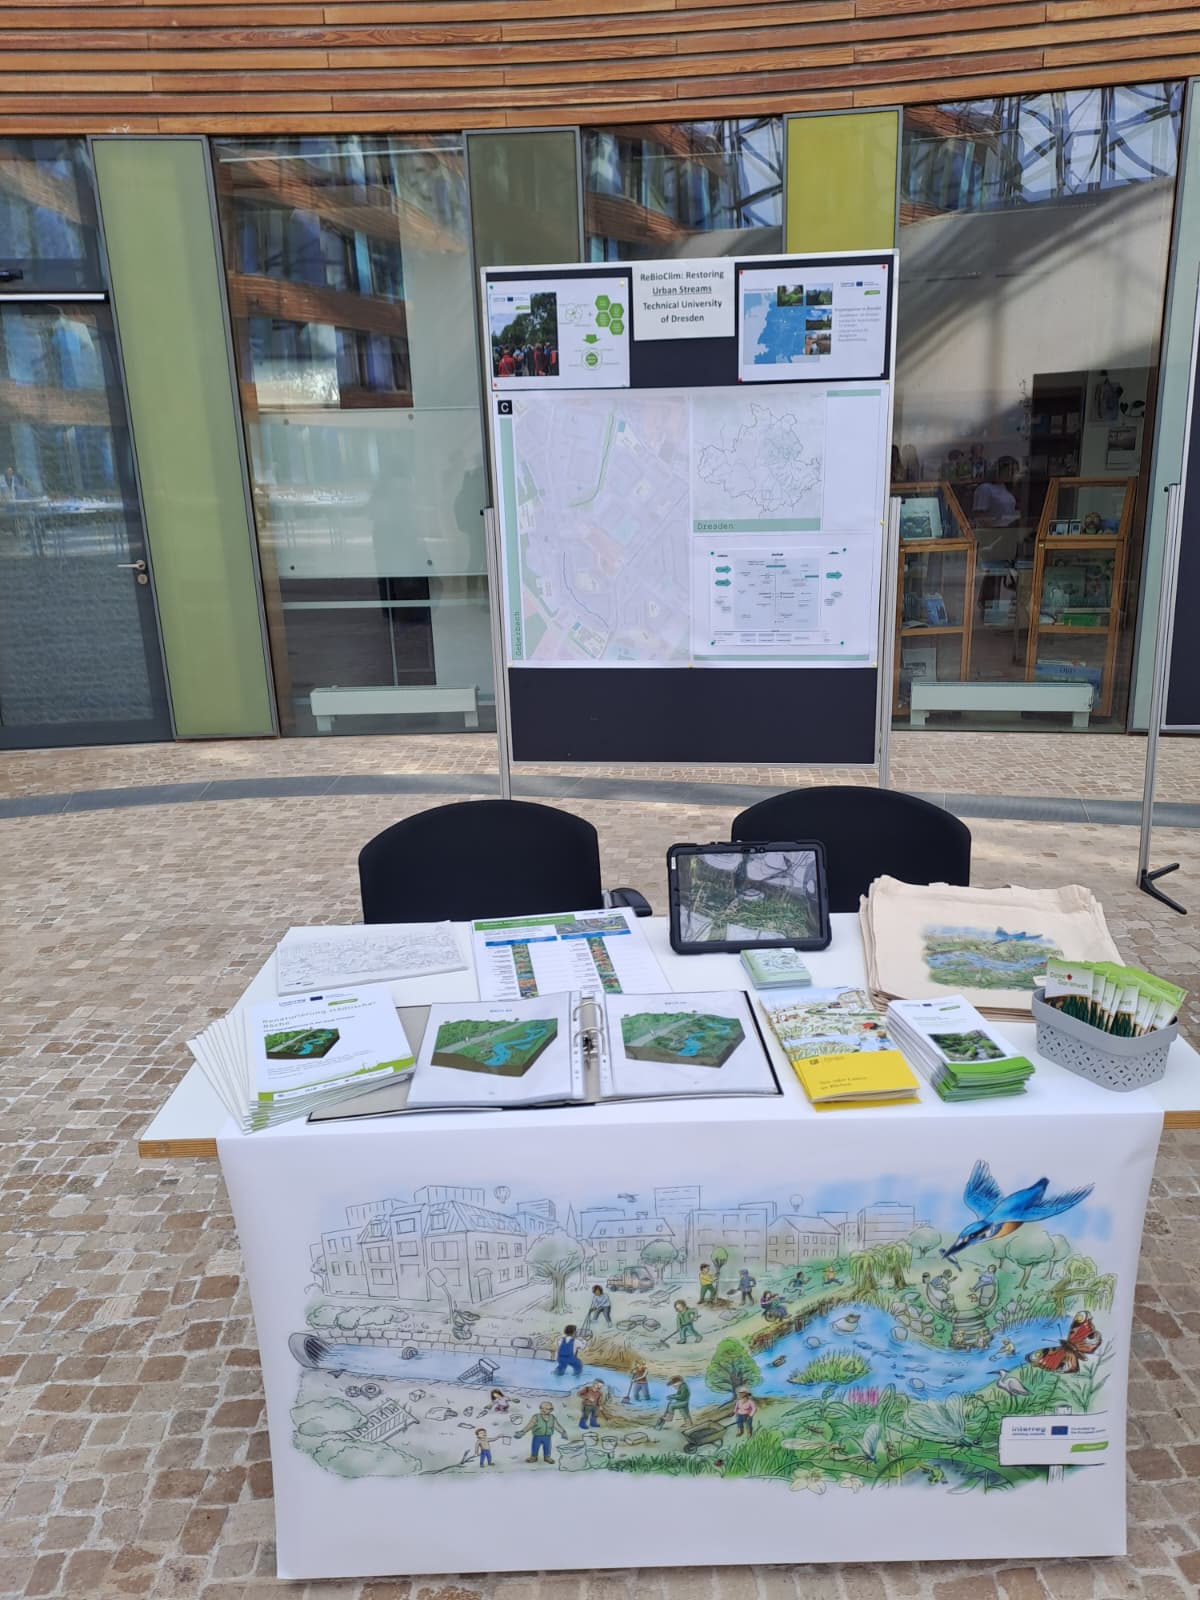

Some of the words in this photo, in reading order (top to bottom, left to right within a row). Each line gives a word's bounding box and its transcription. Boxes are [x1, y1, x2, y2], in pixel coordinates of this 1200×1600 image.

[685, 269, 724, 281] Restoring
[652, 286, 677, 296] Urban
[679, 285, 712, 294] Streams
[643, 300, 680, 311] Technical
[681, 299, 723, 310] University
[660, 314, 669, 323] of
[671, 313, 705, 323] Dresden
[500, 402, 509, 413] C
[697, 522, 734, 530] Dresden
